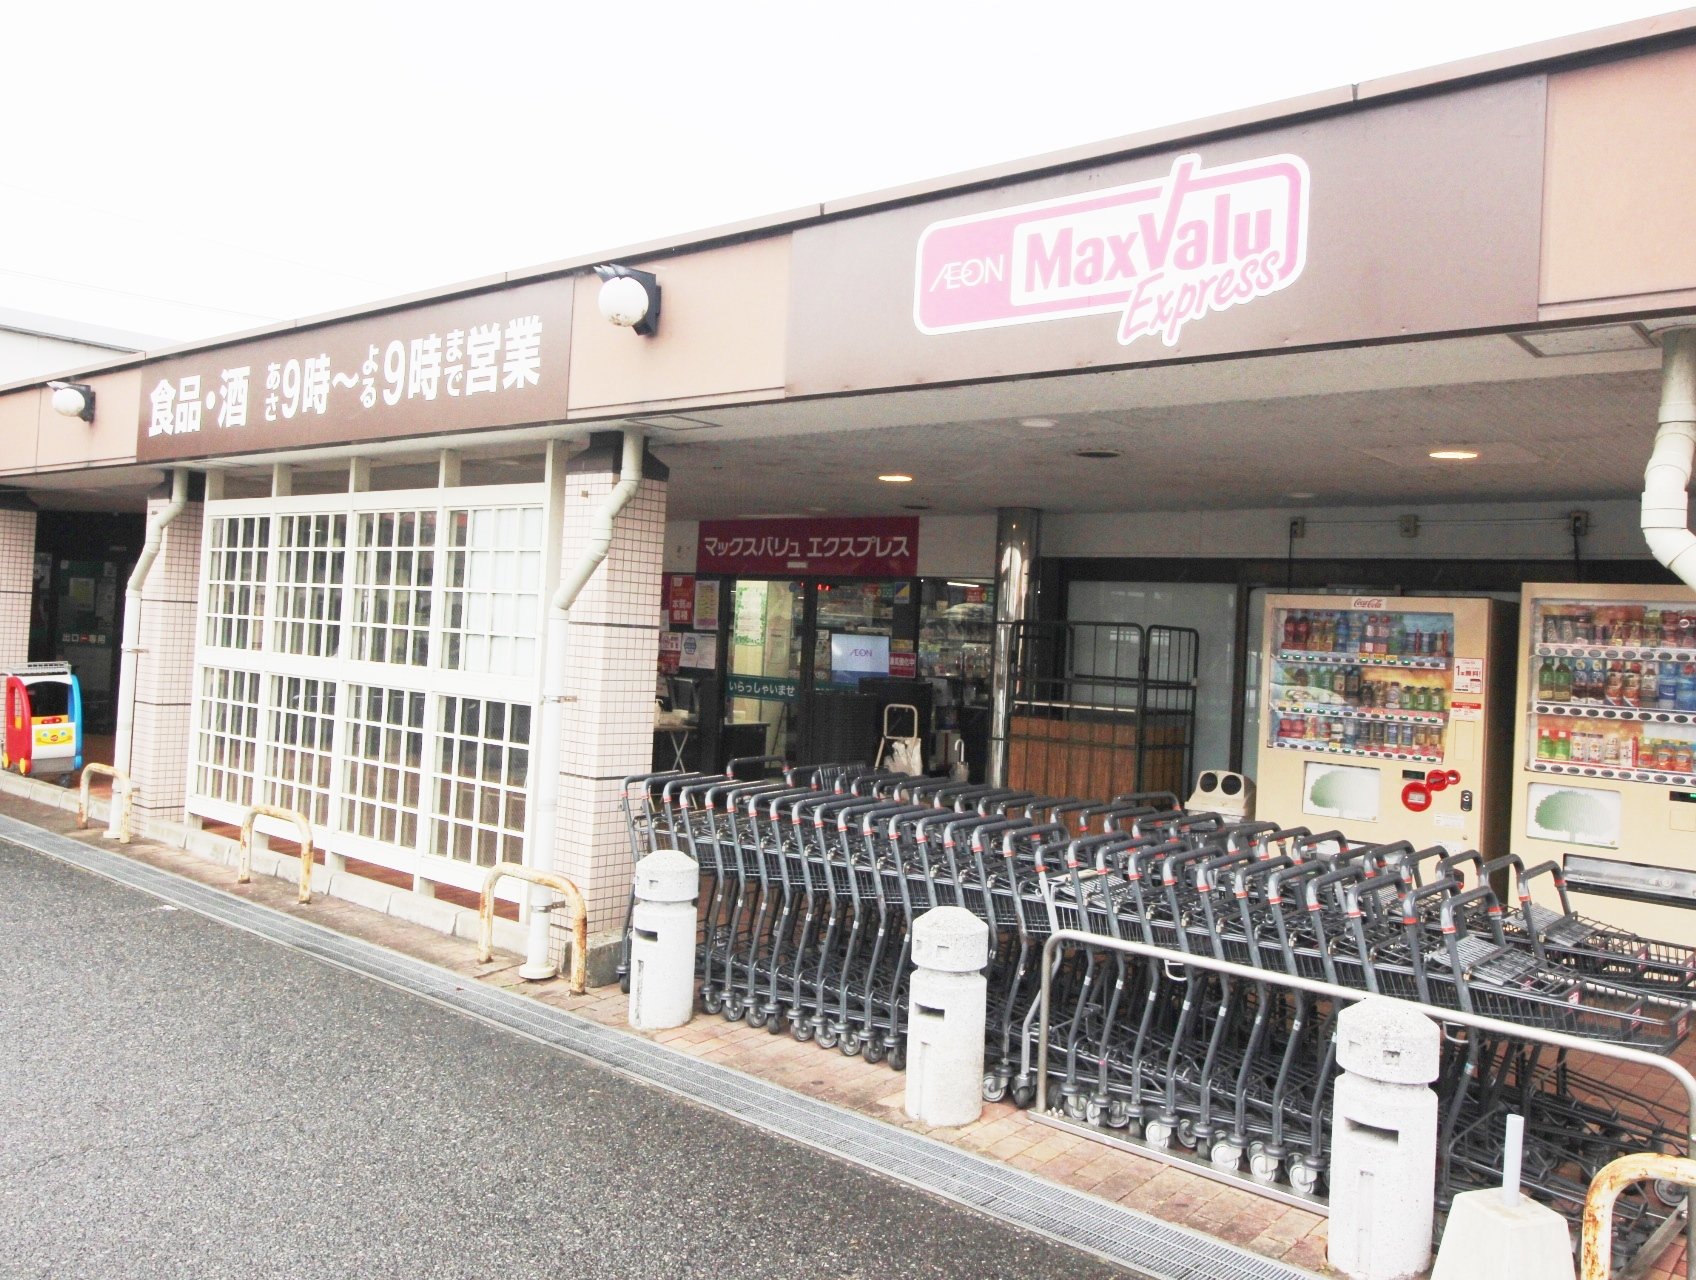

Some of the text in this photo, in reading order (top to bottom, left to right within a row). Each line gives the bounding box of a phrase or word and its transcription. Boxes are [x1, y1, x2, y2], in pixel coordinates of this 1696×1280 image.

[1025, 162, 1273, 293] MaxValu
[929, 254, 1004, 293] AEON
[1122, 250, 1280, 341] Express
[148, 366, 250, 437] 食品・酒
[704, 536, 910, 557] マックスバリュ エクスプレス
[849, 648, 873, 657] AEON
[729, 682, 796, 697] いらっしゃいませ
